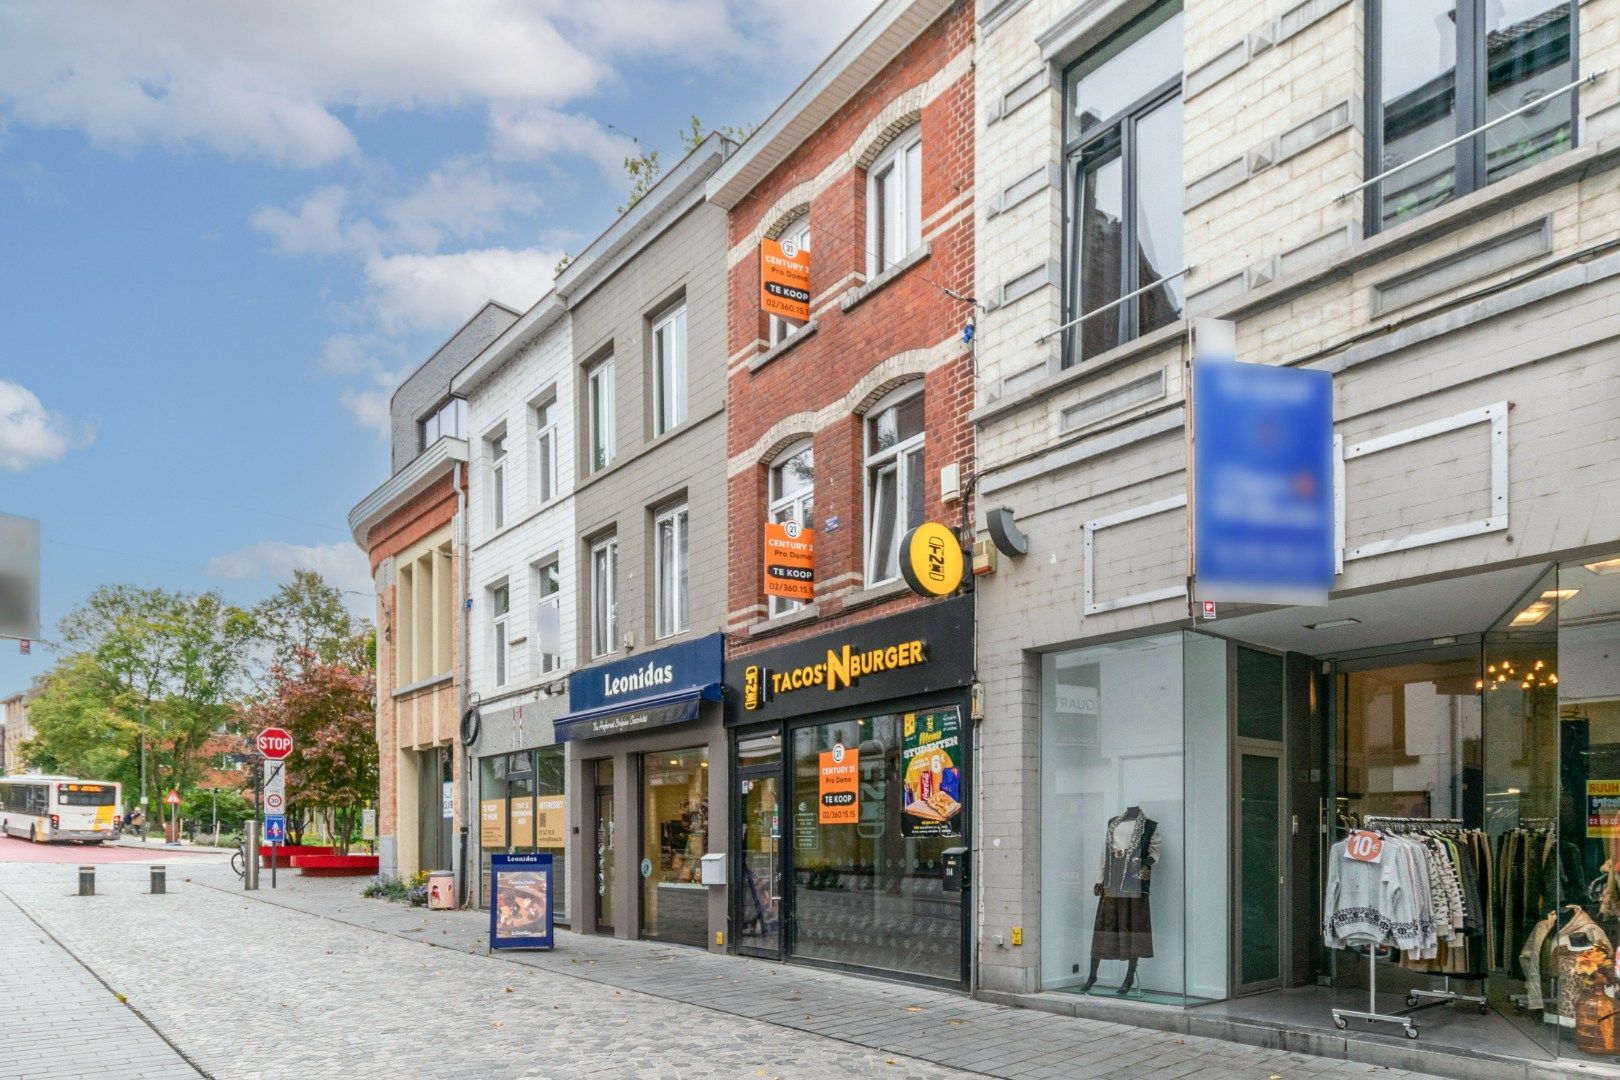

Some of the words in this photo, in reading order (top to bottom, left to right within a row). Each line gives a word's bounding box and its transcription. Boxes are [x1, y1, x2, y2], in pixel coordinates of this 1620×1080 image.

[786, 244, 794, 253] 21
[765, 256, 804, 272] CENTURY
[771, 266, 784, 276] Pro
[770, 284, 782, 294] TE
[783, 288, 808, 300] KOOP
[766, 299, 809, 316] 02/360.15.1
[789, 525, 797, 533] 21
[768, 539, 807, 551] CENTURY
[774, 549, 788, 557] Pro
[773, 567, 785, 575] TE
[787, 569, 812, 578] KOOP
[769, 582, 813, 594] 02/360.15.1
[604, 661, 673, 697] Leonidas
[259, 736, 291, 751] STOP
[903, 736, 958, 759] STUDENTEN
[822, 765, 848, 775] CENTURY
[825, 795, 833, 804] TE
[834, 794, 852, 803] KOOP
[822, 810, 856, 819] 02/360.15.15
